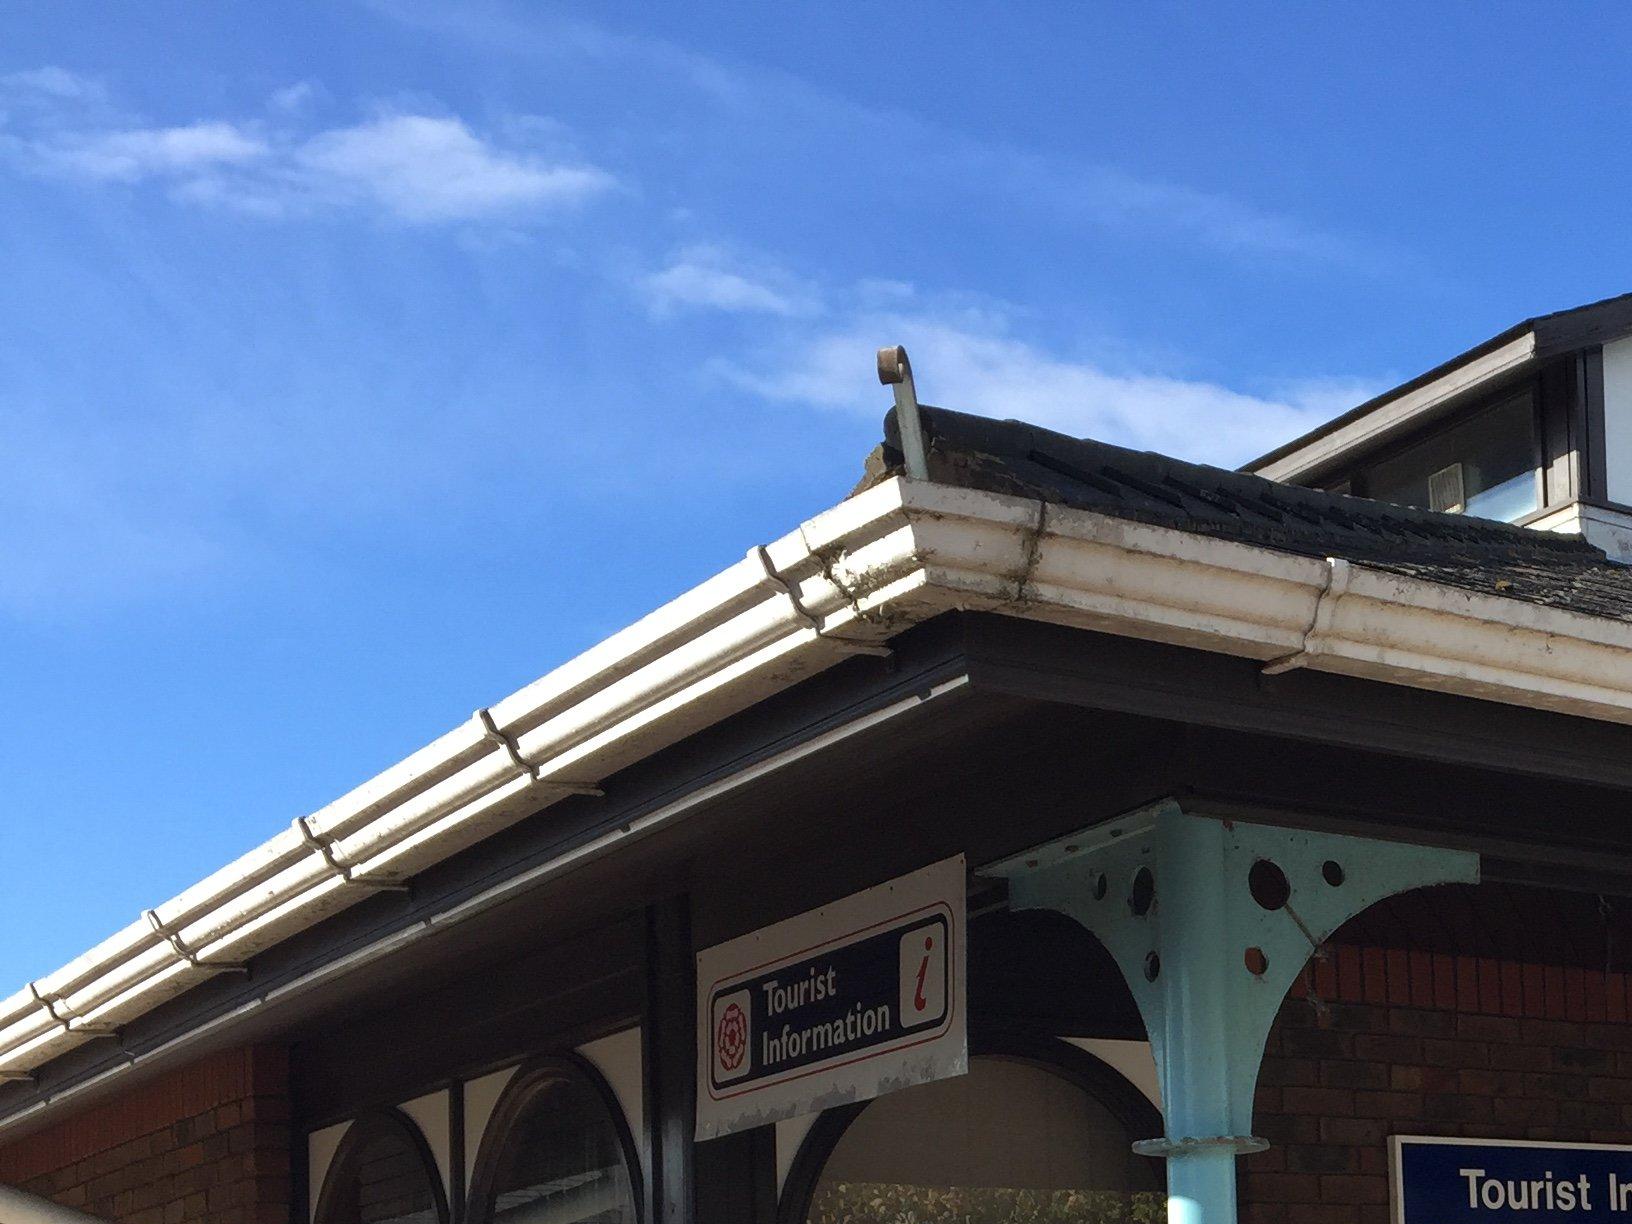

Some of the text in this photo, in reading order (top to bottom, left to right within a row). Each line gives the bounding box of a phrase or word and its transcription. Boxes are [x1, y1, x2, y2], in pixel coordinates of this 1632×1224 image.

[763, 965, 837, 1016] Tourist
[914, 937, 933, 1012] i
[762, 1003, 890, 1066] Information
[1460, 1169, 1591, 1212] Tourist
